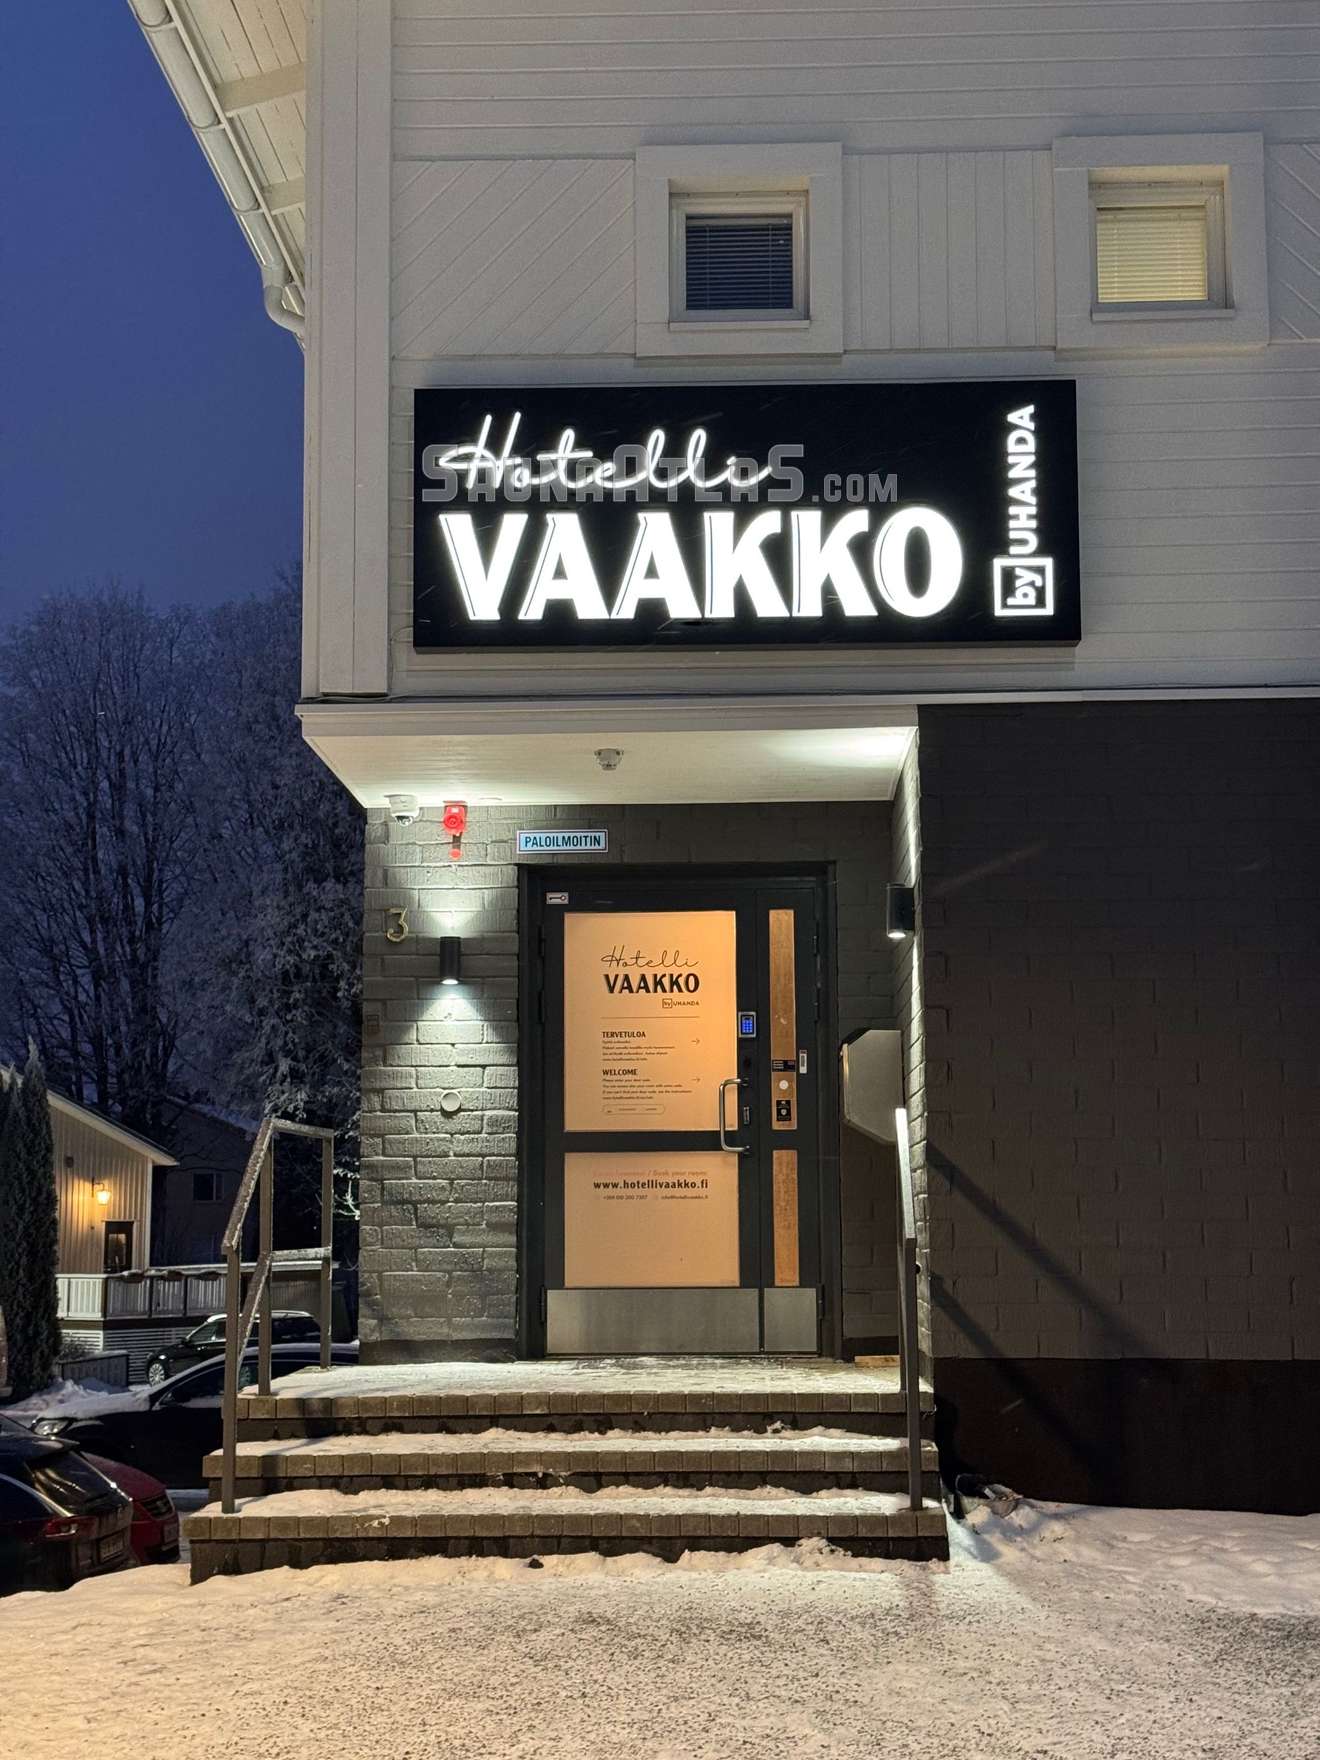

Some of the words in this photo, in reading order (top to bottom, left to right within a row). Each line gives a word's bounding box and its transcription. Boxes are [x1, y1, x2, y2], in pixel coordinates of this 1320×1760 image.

[438, 411, 772, 490] Hotelli
[1007, 404, 1038, 556] UHANDA
[438, 506, 964, 620] VAAKKO
[1006, 566, 1043, 606] by
[524, 835, 602, 848] PALOILMOITIN
[385, 904, 409, 943] 3
[600, 944, 700, 968] Hotelli
[603, 973, 700, 994] VAAKKO
[602, 1068, 638, 1076] WELCOME
[593, 1179, 708, 1189] www.hotellivaakko.fi
